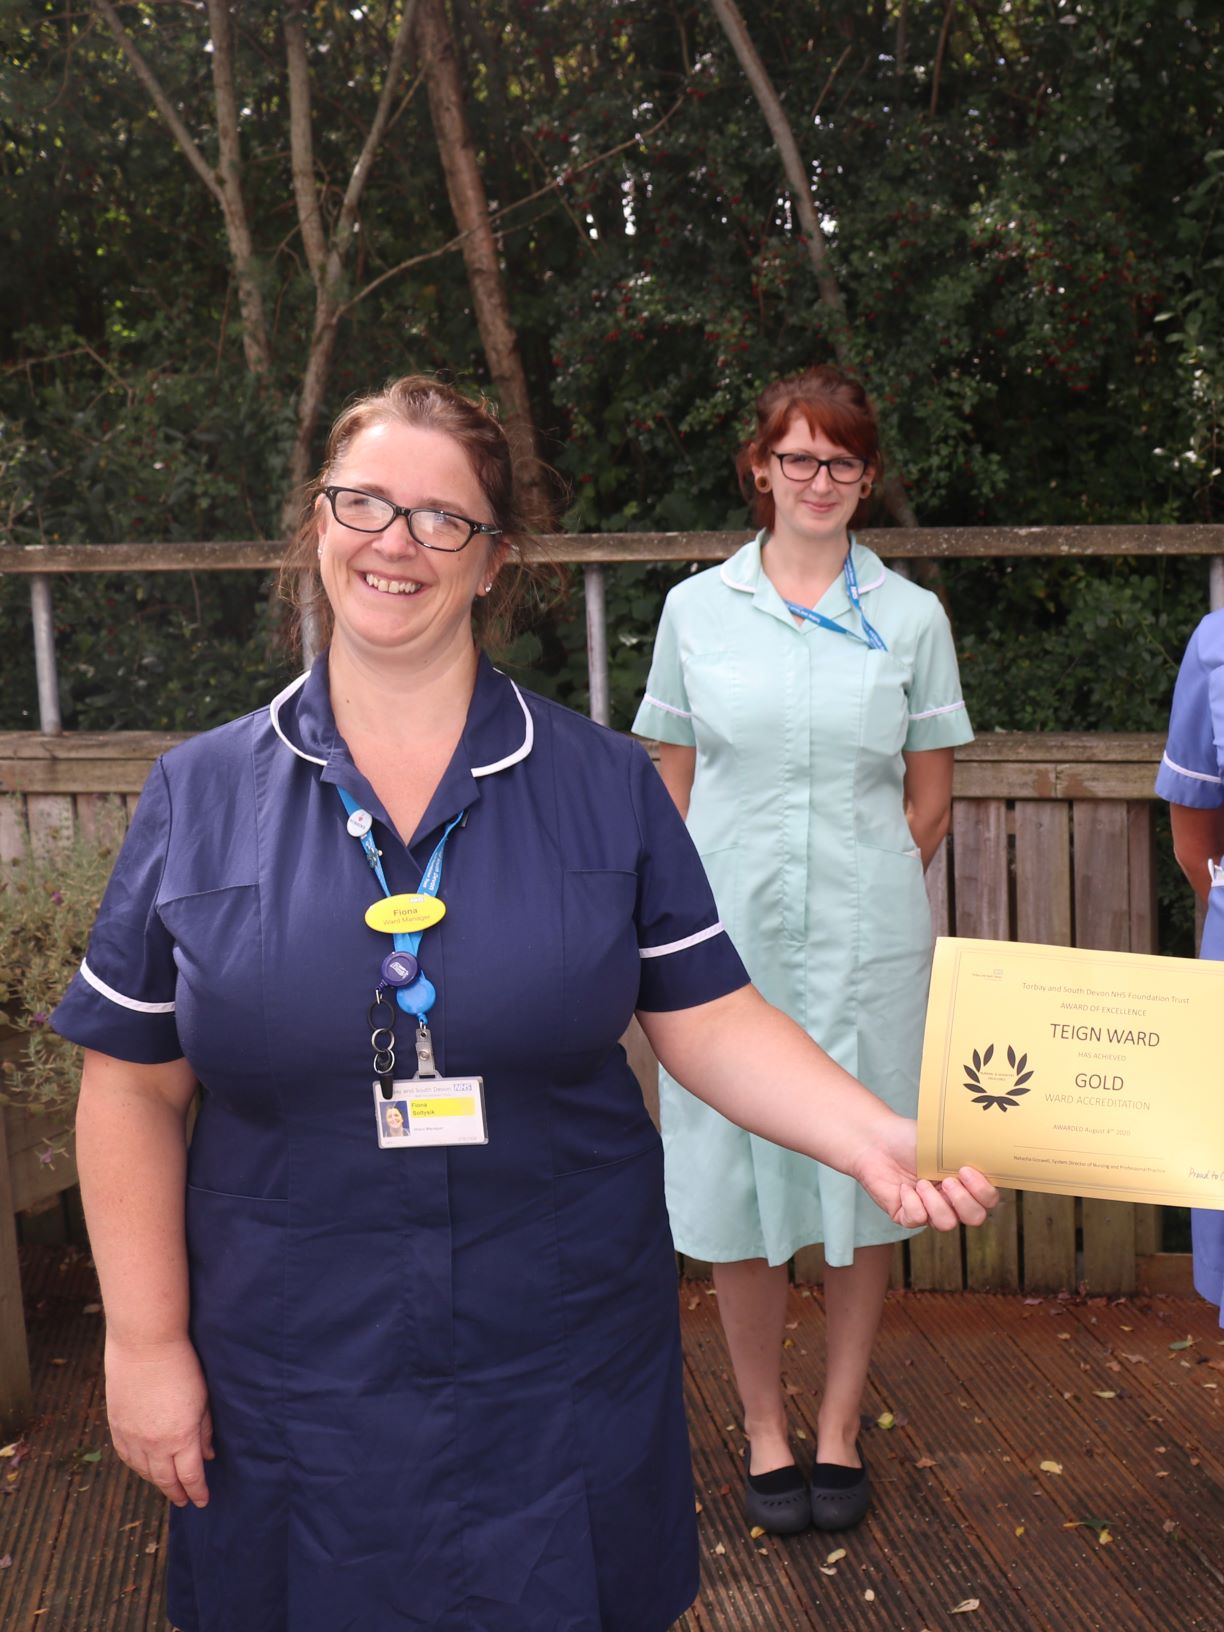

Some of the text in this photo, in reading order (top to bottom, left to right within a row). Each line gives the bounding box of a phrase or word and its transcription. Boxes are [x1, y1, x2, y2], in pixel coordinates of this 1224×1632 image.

[429, 872, 438, 891] Devon
[393, 908, 418, 916] Fiona
[1022, 982, 1046, 992] Torbay
[1063, 986, 1084, 994] South
[1087, 988, 1109, 997] Devon
[1111, 991, 1126, 999] NHS
[1128, 992, 1169, 1003] Foundation
[1171, 996, 1190, 1004] Trust
[1060, 1002, 1088, 1011] AWARD
[1102, 1007, 1147, 1016] EXCELLENCE
[1050, 1023, 1160, 1047] TEIGN WARD
[1093, 1052, 1126, 1062] ACHIEVED
[453, 1083, 472, 1092] NHS
[1074, 1072, 1124, 1091] GOLD
[1045, 1093, 1151, 1111] WARD ACCREDITATION
[1053, 1124, 1083, 1133] AWARDED
[1084, 1126, 1105, 1135] August
[1188, 1167, 1209, 1179] Proud
[1211, 1171, 1218, 1180] to
